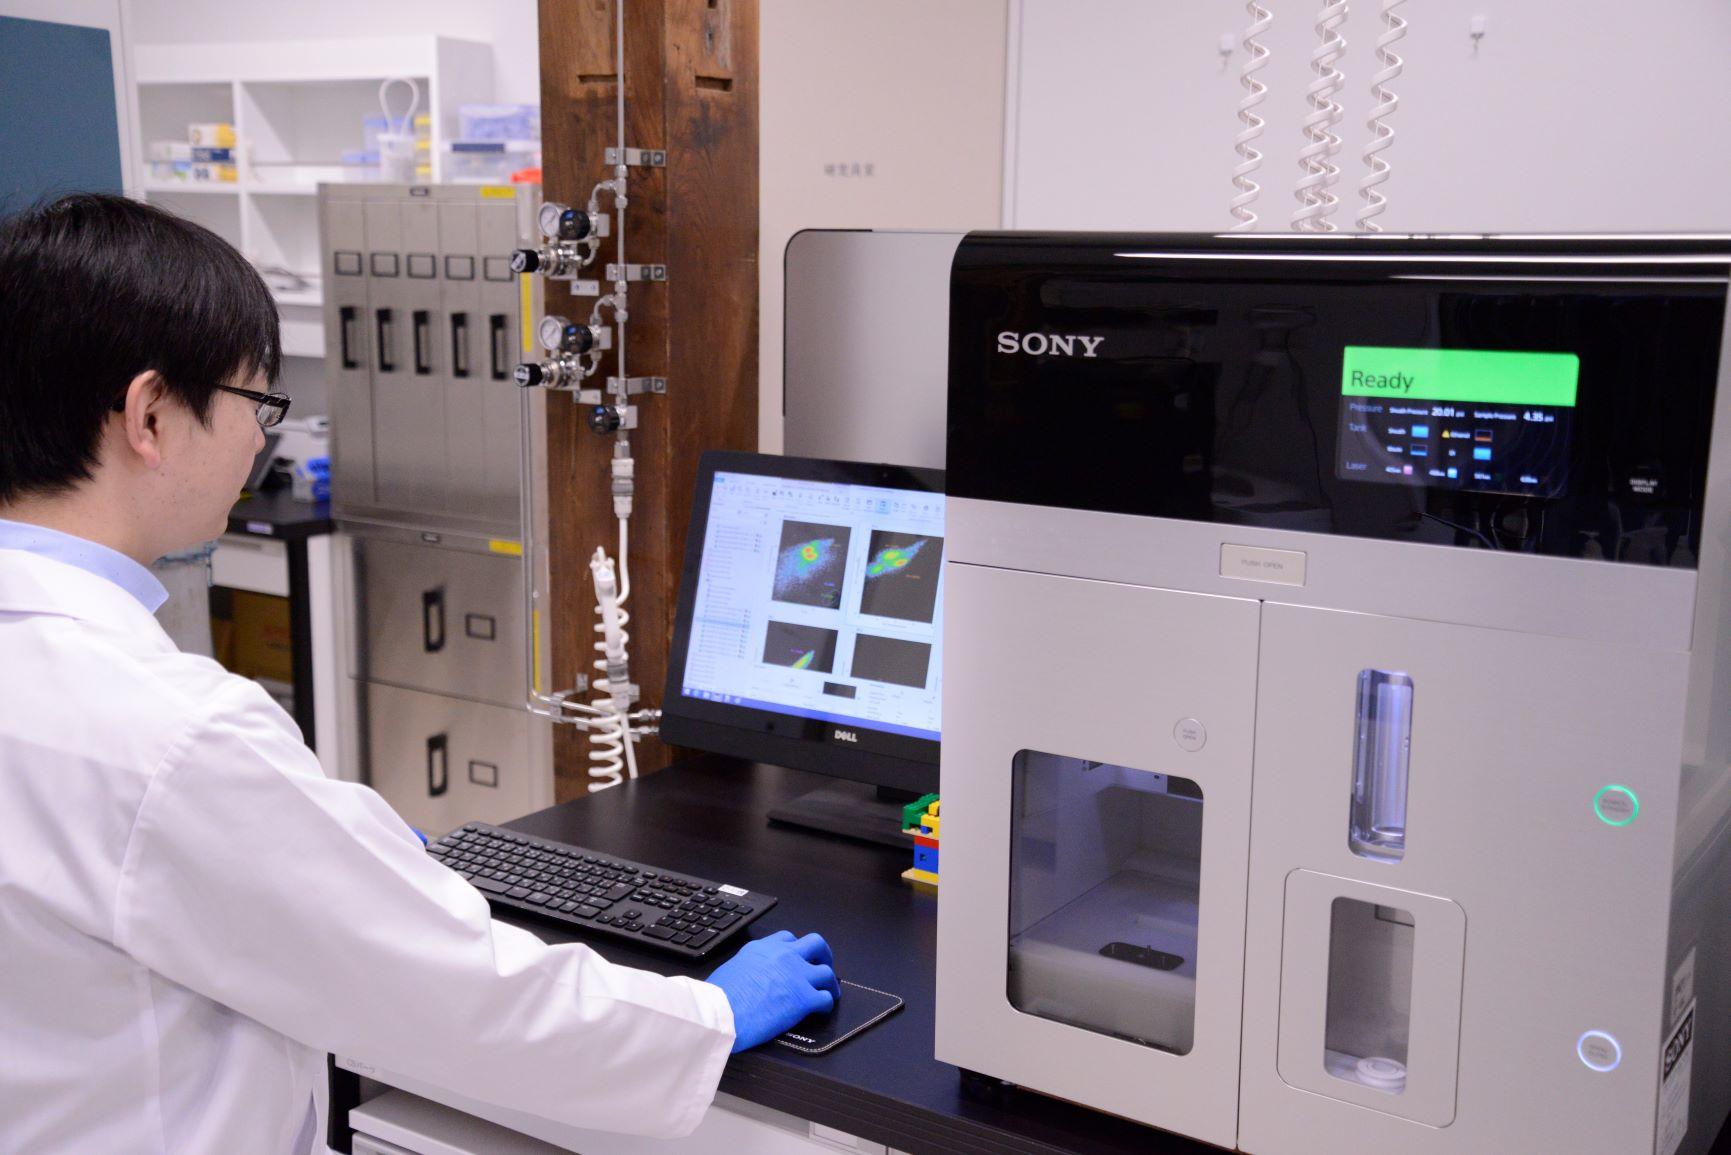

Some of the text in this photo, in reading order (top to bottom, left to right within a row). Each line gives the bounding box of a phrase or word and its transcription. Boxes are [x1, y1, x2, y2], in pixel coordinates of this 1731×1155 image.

[997, 331, 1105, 357] SONY
[1351, 370, 1415, 394] Ready
[834, 729, 858, 743] DELL
